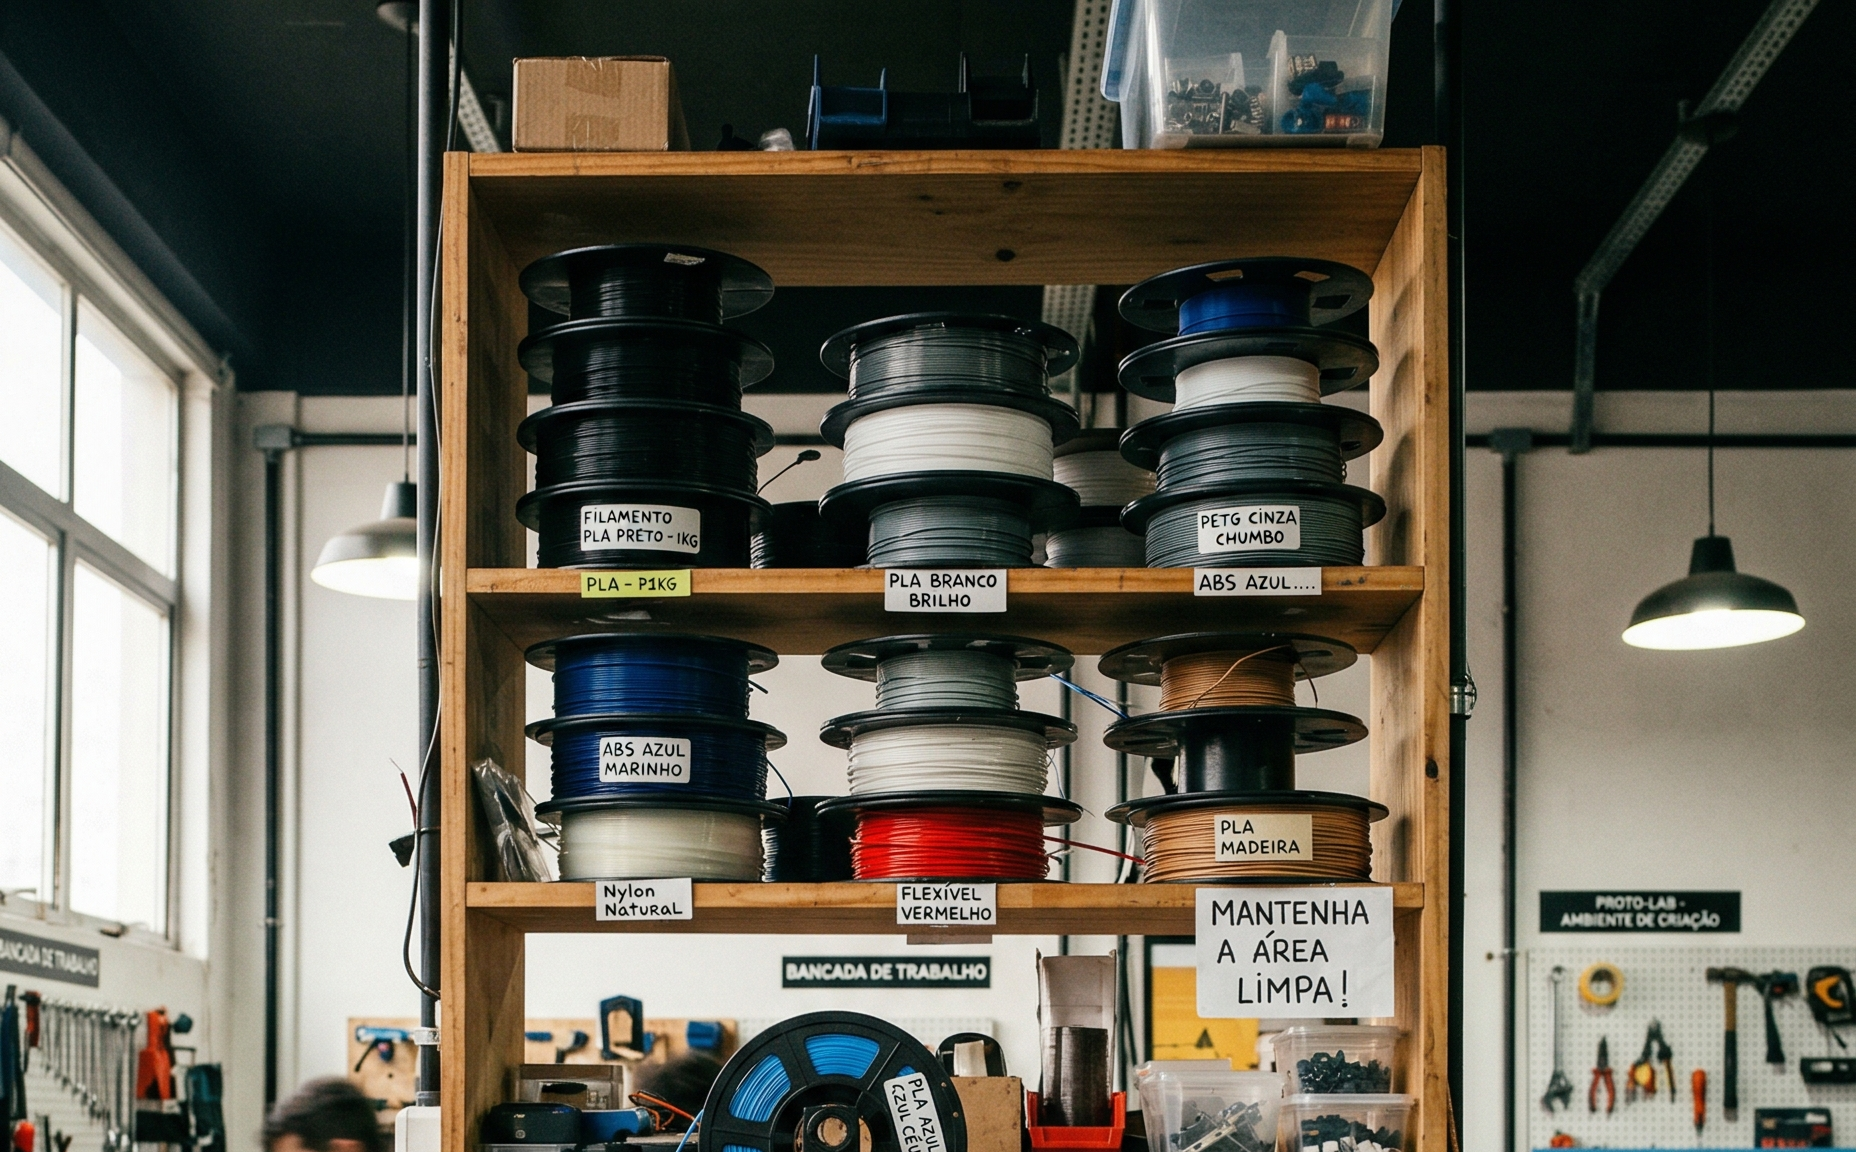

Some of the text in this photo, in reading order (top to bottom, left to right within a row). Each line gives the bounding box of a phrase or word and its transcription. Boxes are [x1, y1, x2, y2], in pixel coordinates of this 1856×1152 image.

[584, 507, 672, 524] FILAMENTO
[1201, 508, 1297, 529] PETG CINZA
[584, 529, 611, 543] PLA
[1216, 530, 1284, 546] CHUMBO
[587, 577, 620, 592] PLA
[639, 577, 677, 592] P1KG
[889, 573, 997, 589] PLA BRANCO
[1199, 574, 1236, 591] ABS
[909, 593, 971, 607] BRILHO
[603, 742, 685, 757] ABS AZUL
[604, 762, 682, 777] MARINHO
[1221, 819, 1254, 834] PLA
[1221, 840, 1300, 855] MADEIRA
[603, 883, 655, 904] Nylon
[901, 881, 982, 901] FLEXÍVEL
[1595, 895, 1677, 910] PROTO-LAB
[901, 906, 992, 921] VERMELHO
[1212, 899, 1370, 926] MANTENHA
[1560, 909, 1720, 931] AMBIENTE DE CRIAÇÃO
[1217, 930, 1329, 964] A ÁREA
[785, 962, 988, 980] BANCADA DE TRABALHO
[908, 1078, 928, 1110] PLA
